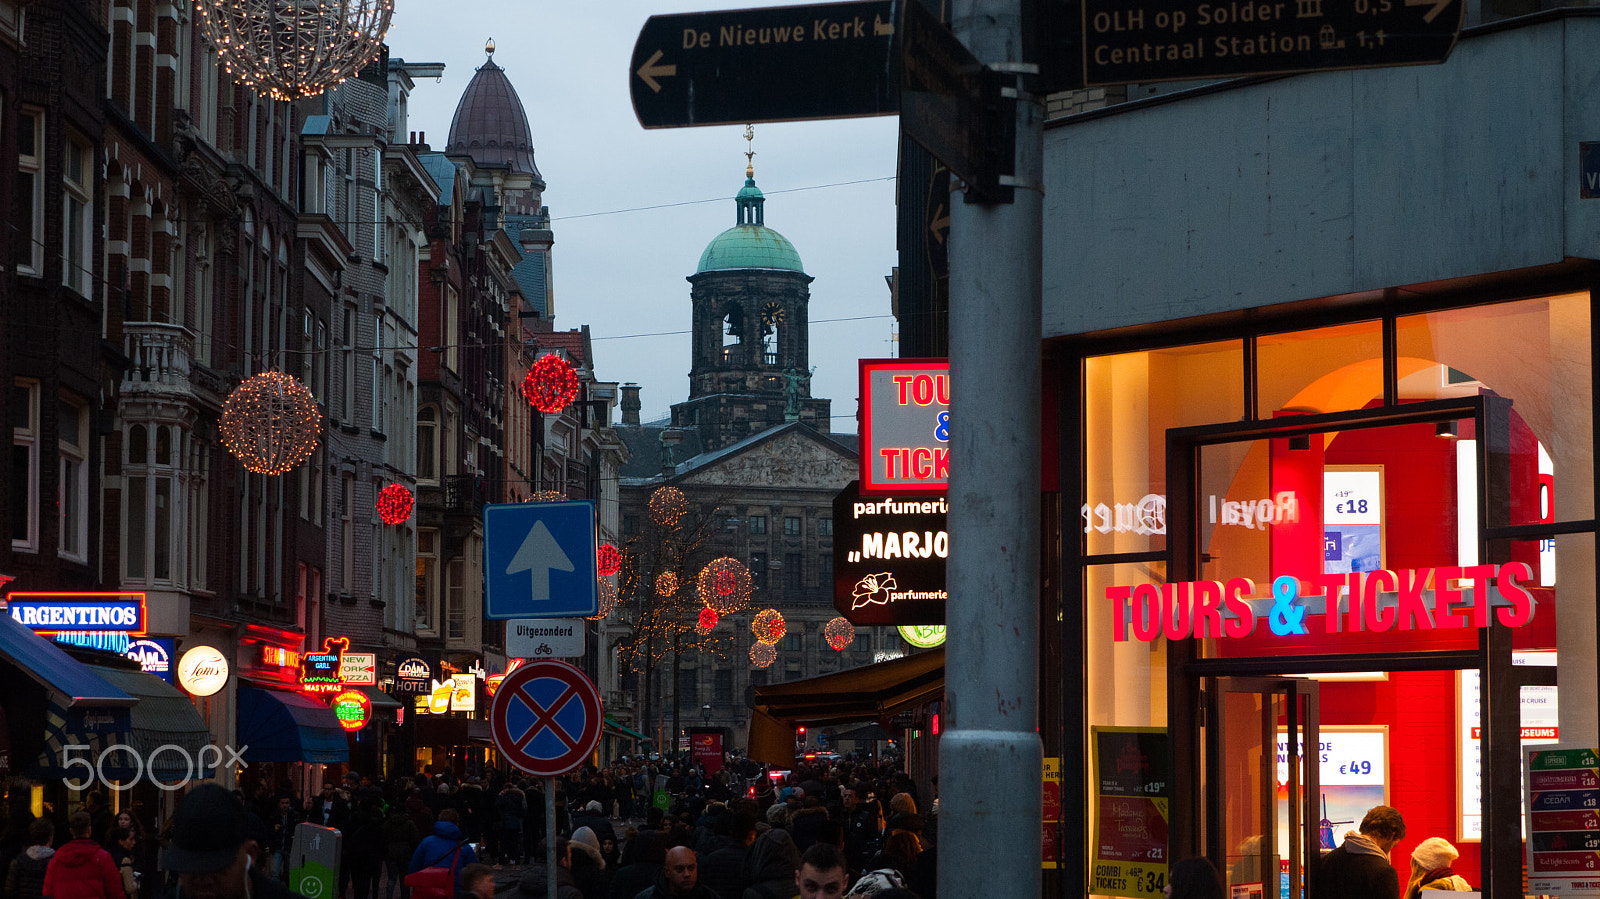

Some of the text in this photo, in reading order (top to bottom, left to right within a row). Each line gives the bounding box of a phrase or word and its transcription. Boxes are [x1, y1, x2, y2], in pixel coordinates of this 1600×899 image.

[1093, 9, 1144, 33] OLH
[1155, 9, 1187, 34] op
[1197, 0, 1286, 26] Solder
[682, 17, 865, 49] De Nieuwe Kerk
[1094, 37, 1204, 65] Centraal
[1215, 32, 1311, 57] Station
[893, 374, 950, 407] TOU
[934, 410, 950, 443] &
[880, 447, 949, 479] TICK
[854, 498, 949, 519] parfumeri
[890, 589, 948, 603] parfumerie
[1105, 561, 1535, 644] TOURS & TICKETS
[12, 606, 137, 626] ARGENTINOS
[517, 625, 573, 639] Uitgezonderd
[127, 646, 159, 665] DAM
[343, 665, 369, 673] ORK
[405, 661, 425, 673] DAM
[304, 684, 320, 692] MAS
[396, 680, 431, 693] HOTEL
[340, 720, 363, 728] TALIANO
[1096, 864, 1121, 877] COMBI
[1096, 876, 1127, 890] TICKETS
